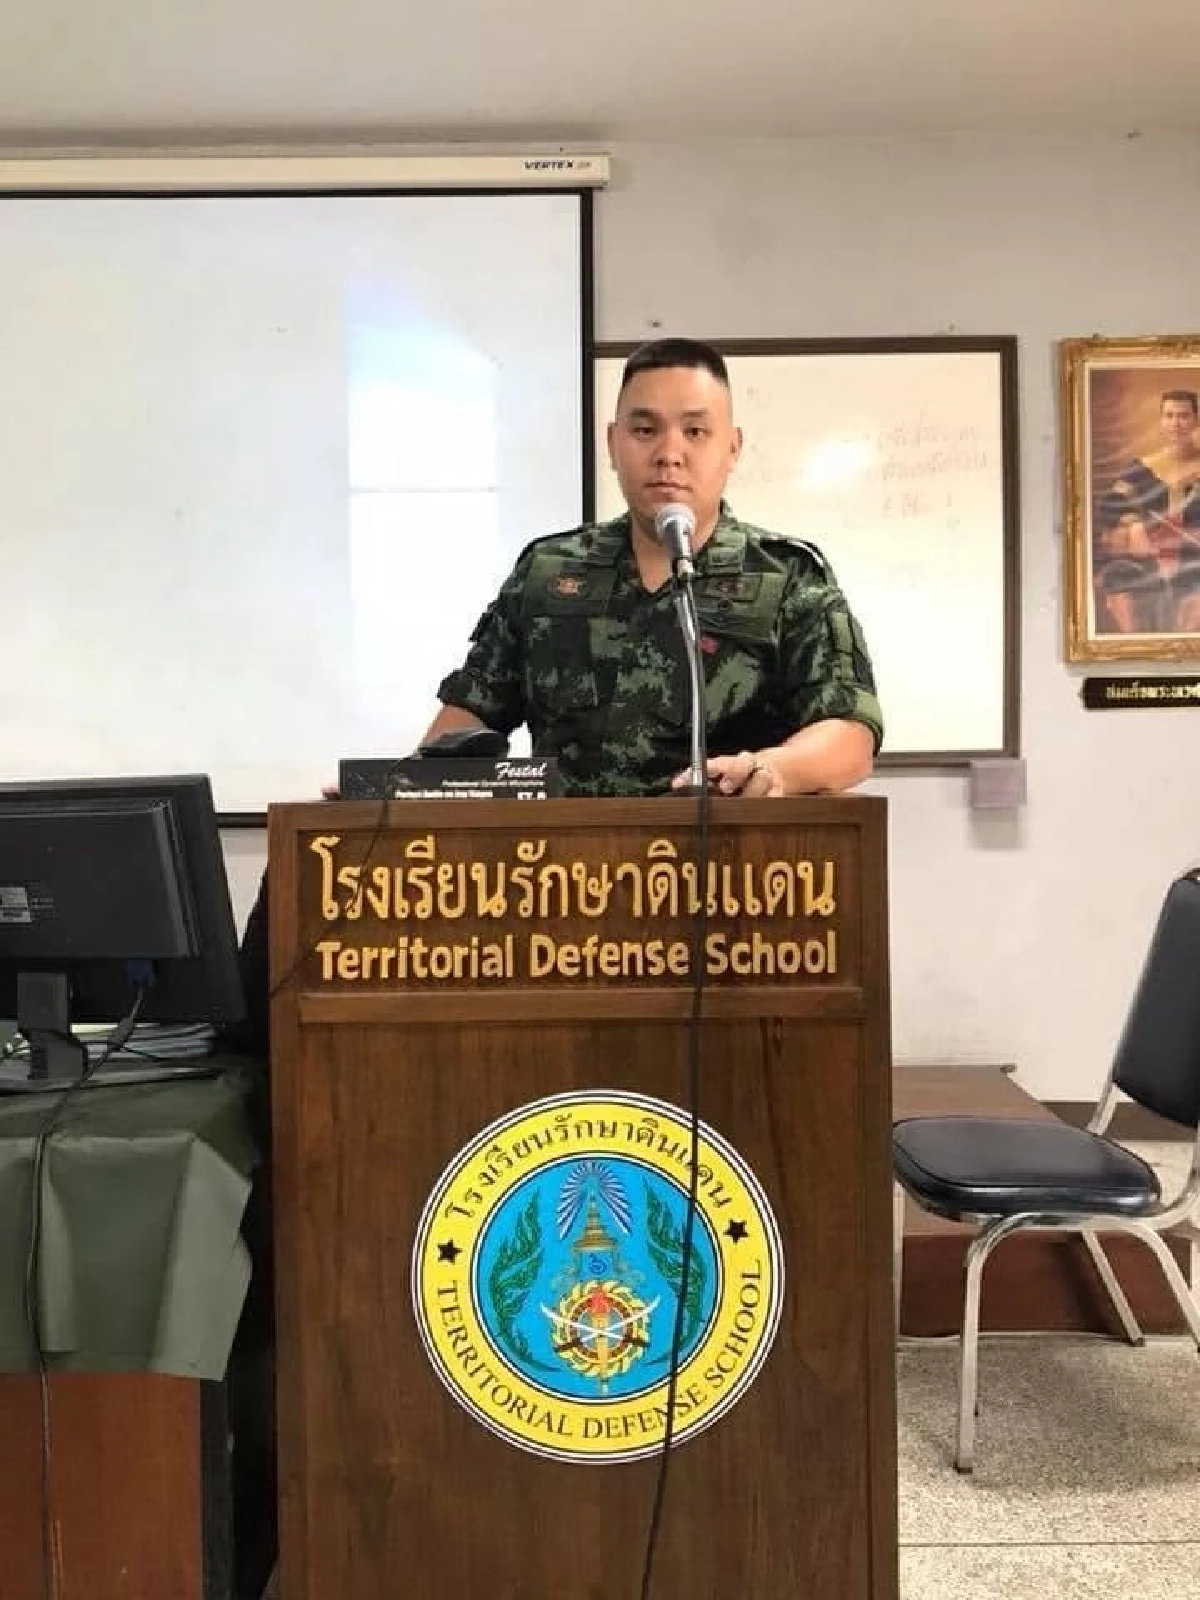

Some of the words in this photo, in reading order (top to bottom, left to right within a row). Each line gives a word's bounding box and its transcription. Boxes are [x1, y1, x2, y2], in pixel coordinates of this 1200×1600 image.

[310, 835, 836, 921] โรงเรียนรักษาดินแดน
[316, 934, 513, 980] Territorial
[529, 934, 690, 979] Defense
[705, 930, 837, 976] School
[437, 1279, 573, 1436] TERRITORIAL
[702, 1258, 763, 1389] SCHOOL
